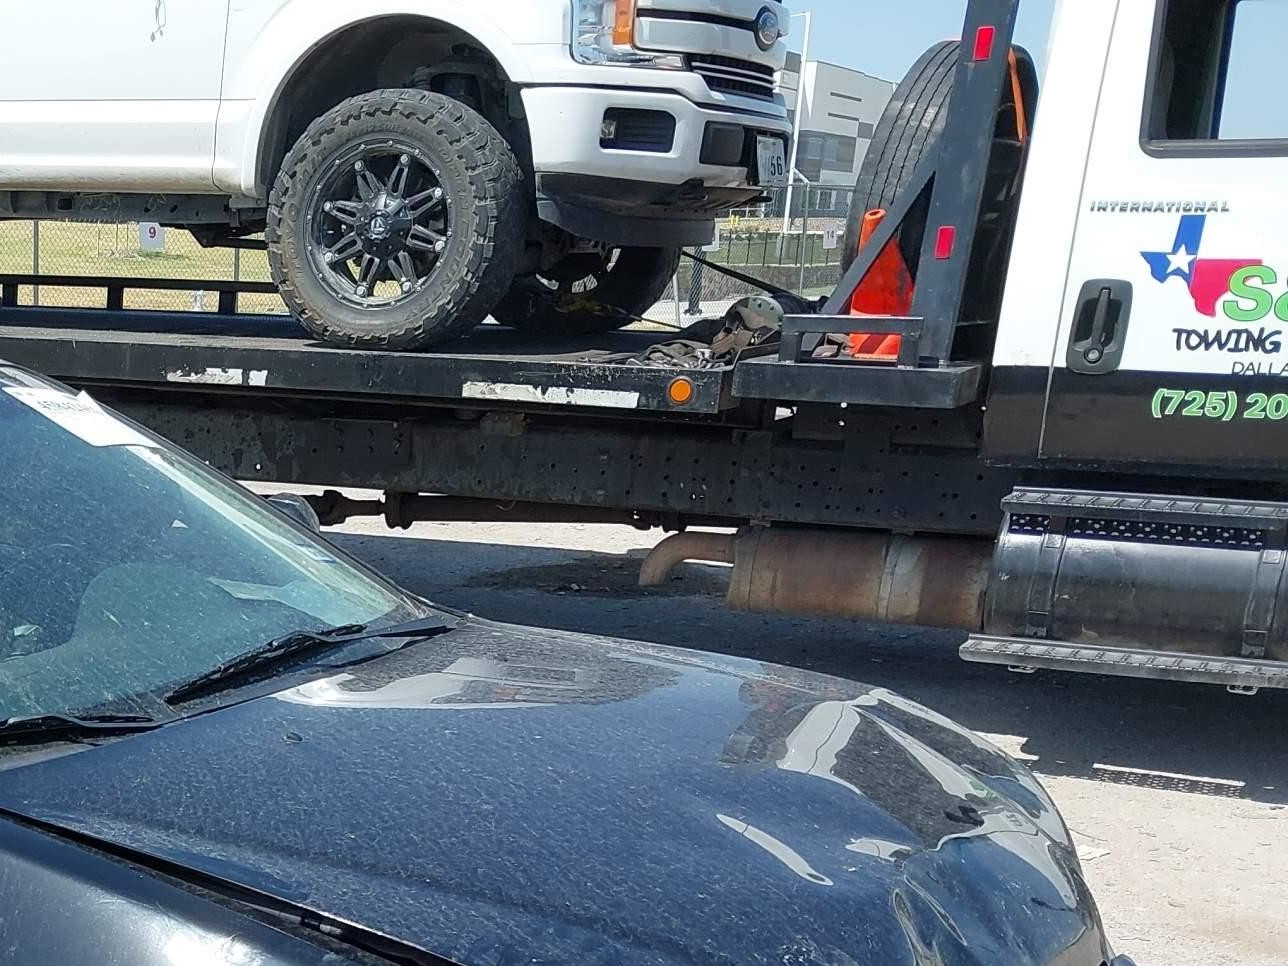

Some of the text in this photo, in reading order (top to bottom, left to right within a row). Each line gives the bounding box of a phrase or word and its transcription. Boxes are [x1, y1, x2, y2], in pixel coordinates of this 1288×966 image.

[1089, 201, 1230, 213] INTERNATIONAL
[148, 226, 157, 239] 9
[1223, 264, 1288, 322] S
[1172, 326, 1282, 354] TOWING
[1152, 389, 1288, 421] (725) 20
